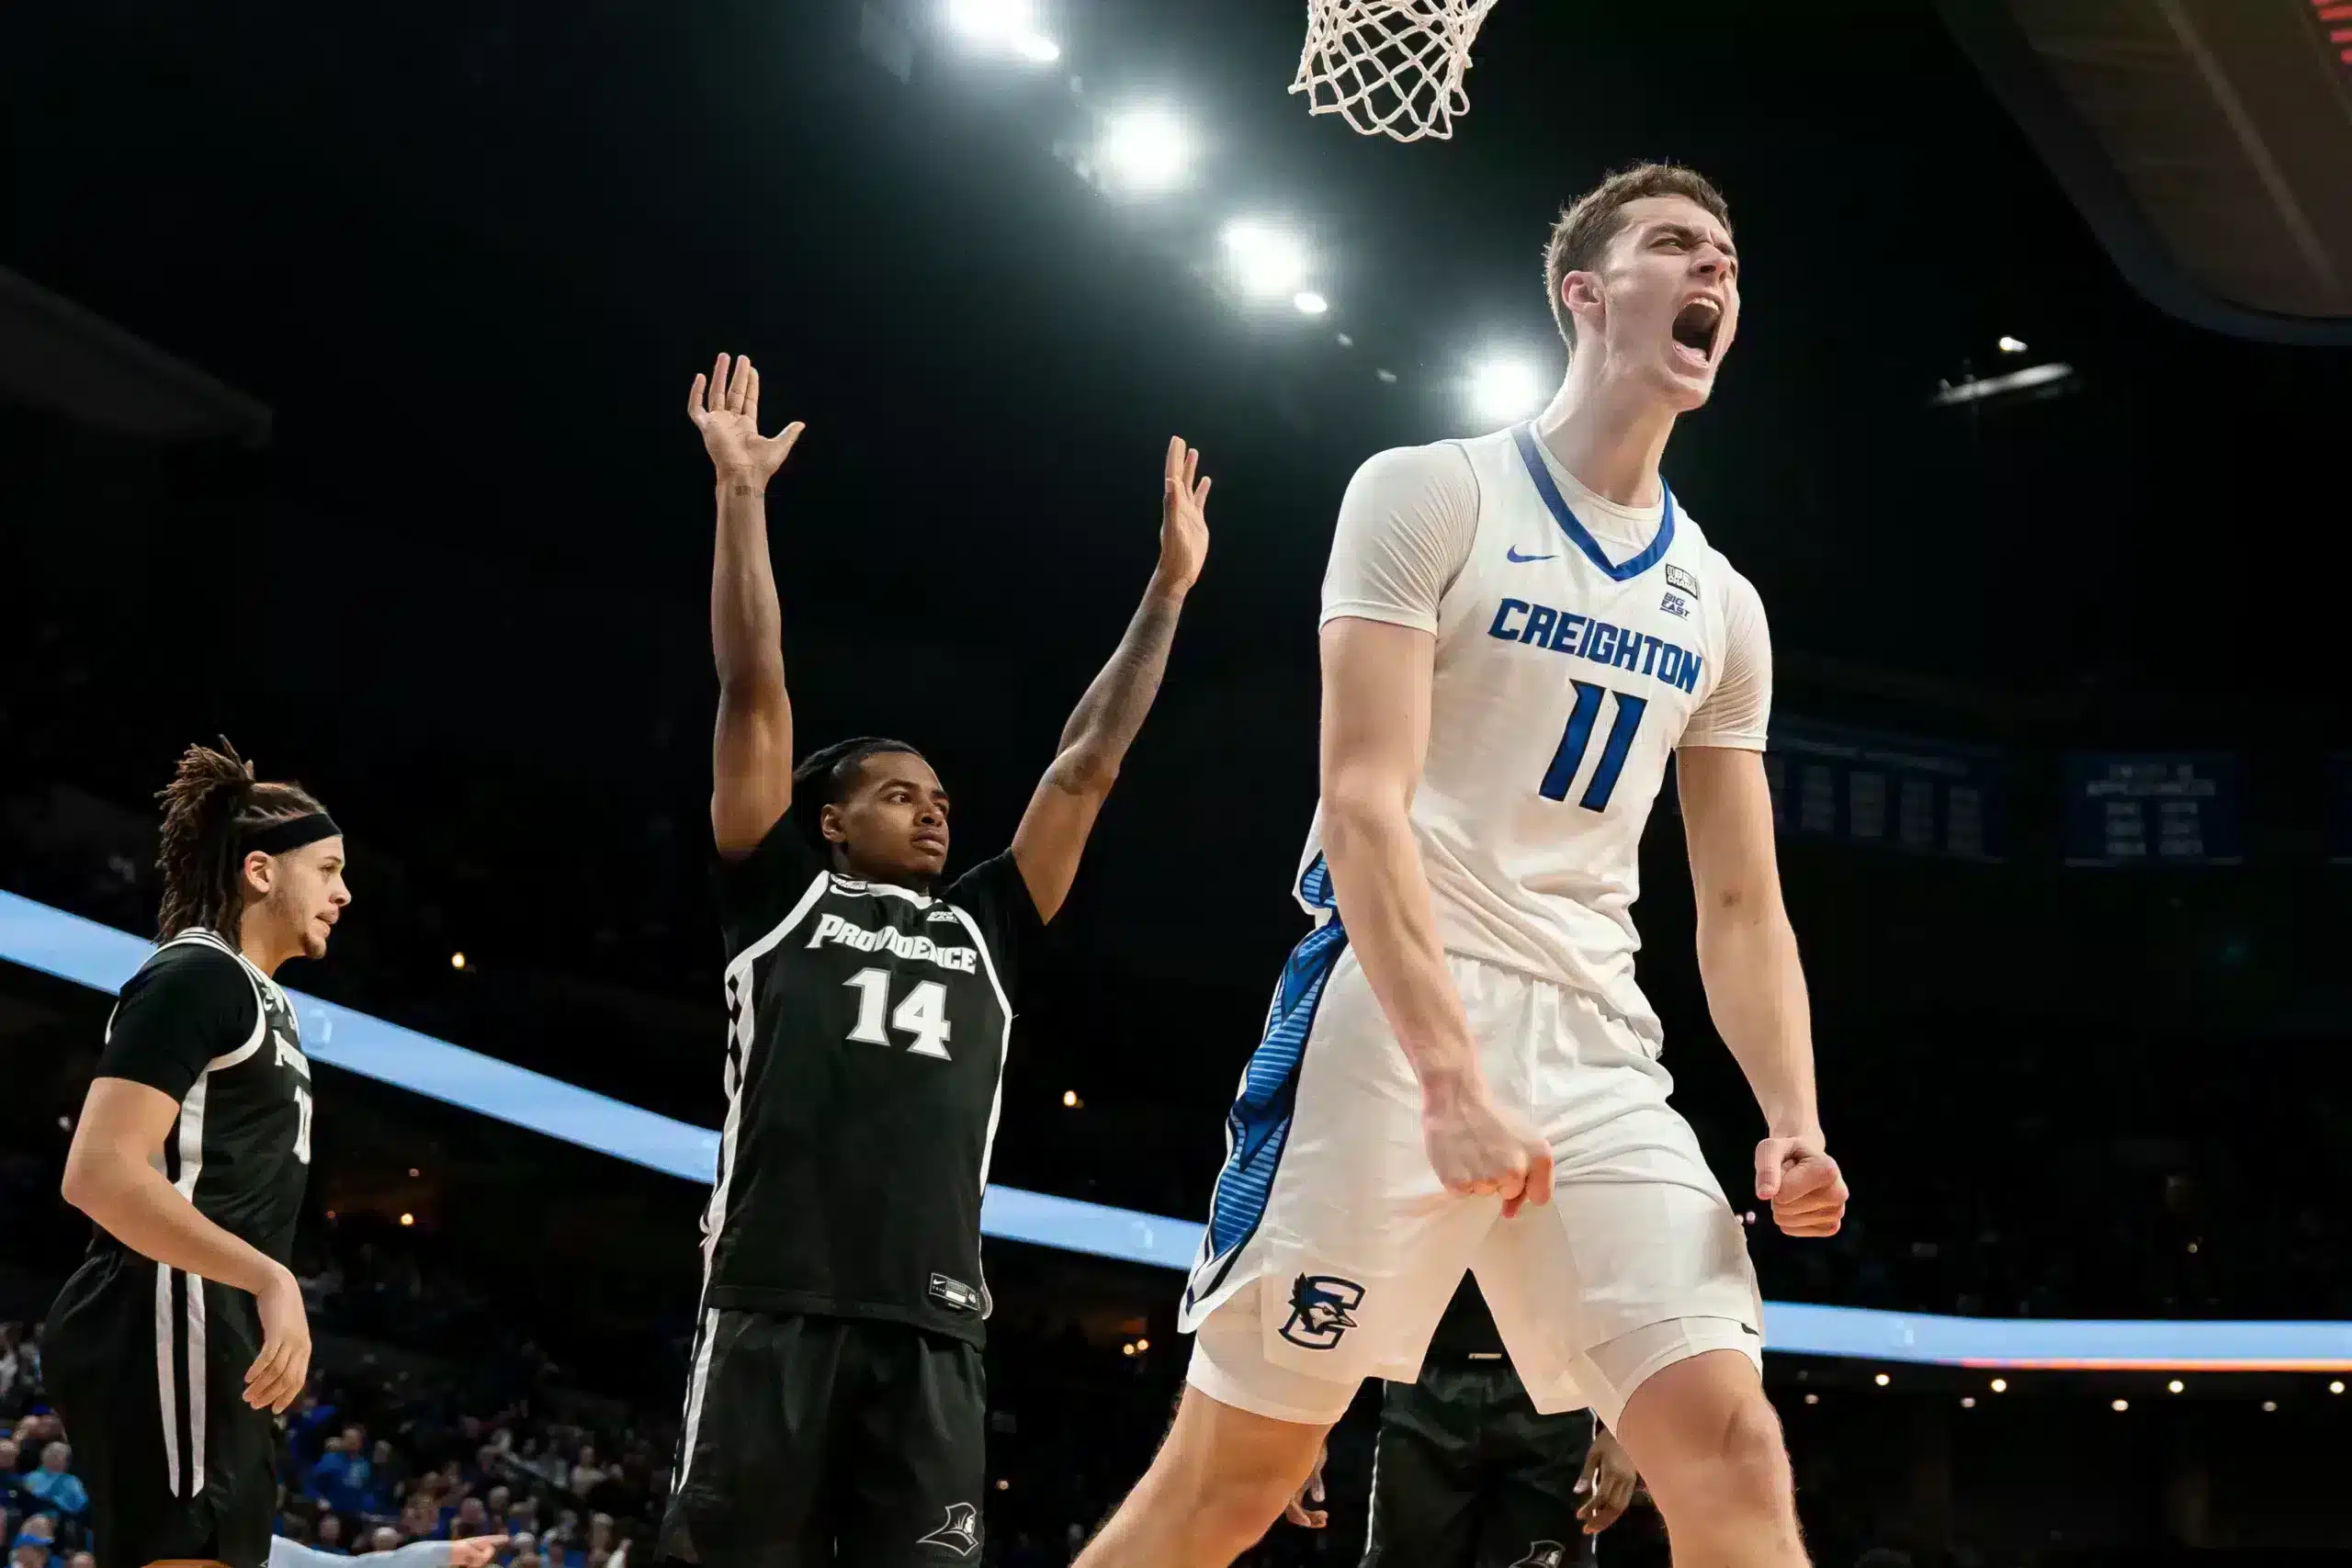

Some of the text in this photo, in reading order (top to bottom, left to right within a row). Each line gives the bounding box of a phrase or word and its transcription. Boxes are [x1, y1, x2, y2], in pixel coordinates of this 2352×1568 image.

[1661, 599, 1690, 617] EAST
[1665, 592, 1685, 607] BIG
[1488, 597, 1702, 694] CREIGHTON
[1538, 678, 1648, 813] 11
[804, 913, 978, 975] PROVIDENCE
[842, 967, 952, 1061] 14
